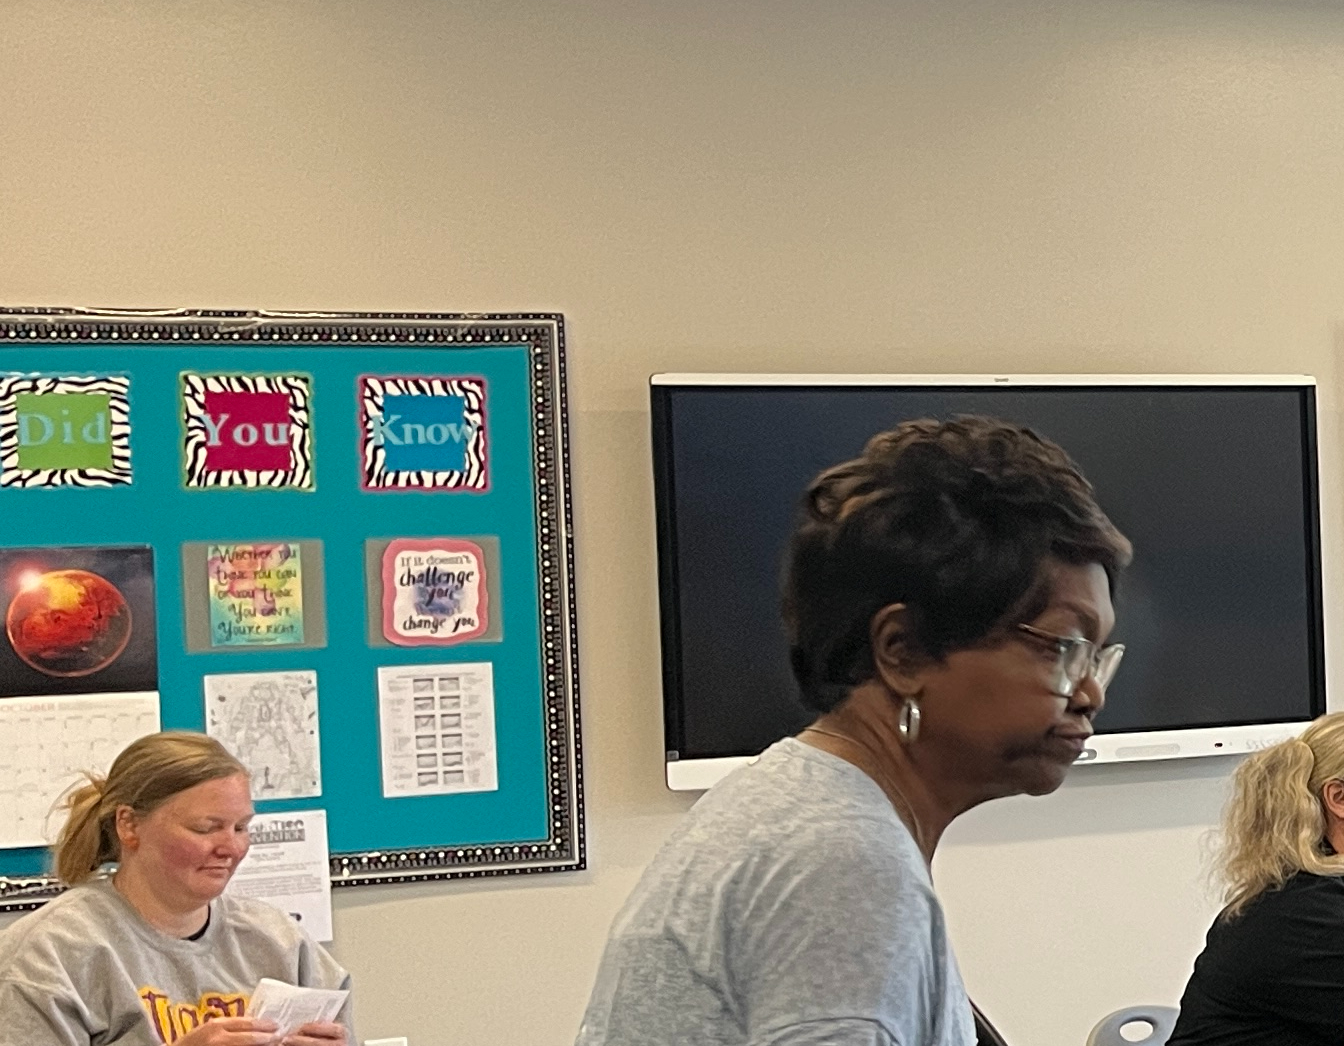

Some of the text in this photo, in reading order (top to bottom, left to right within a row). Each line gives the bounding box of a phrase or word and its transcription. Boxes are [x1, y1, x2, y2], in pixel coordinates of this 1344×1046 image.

[19, 409, 477, 447] Did You Know
[399, 566, 474, 590] challenge
[403, 615, 475, 634] change you
